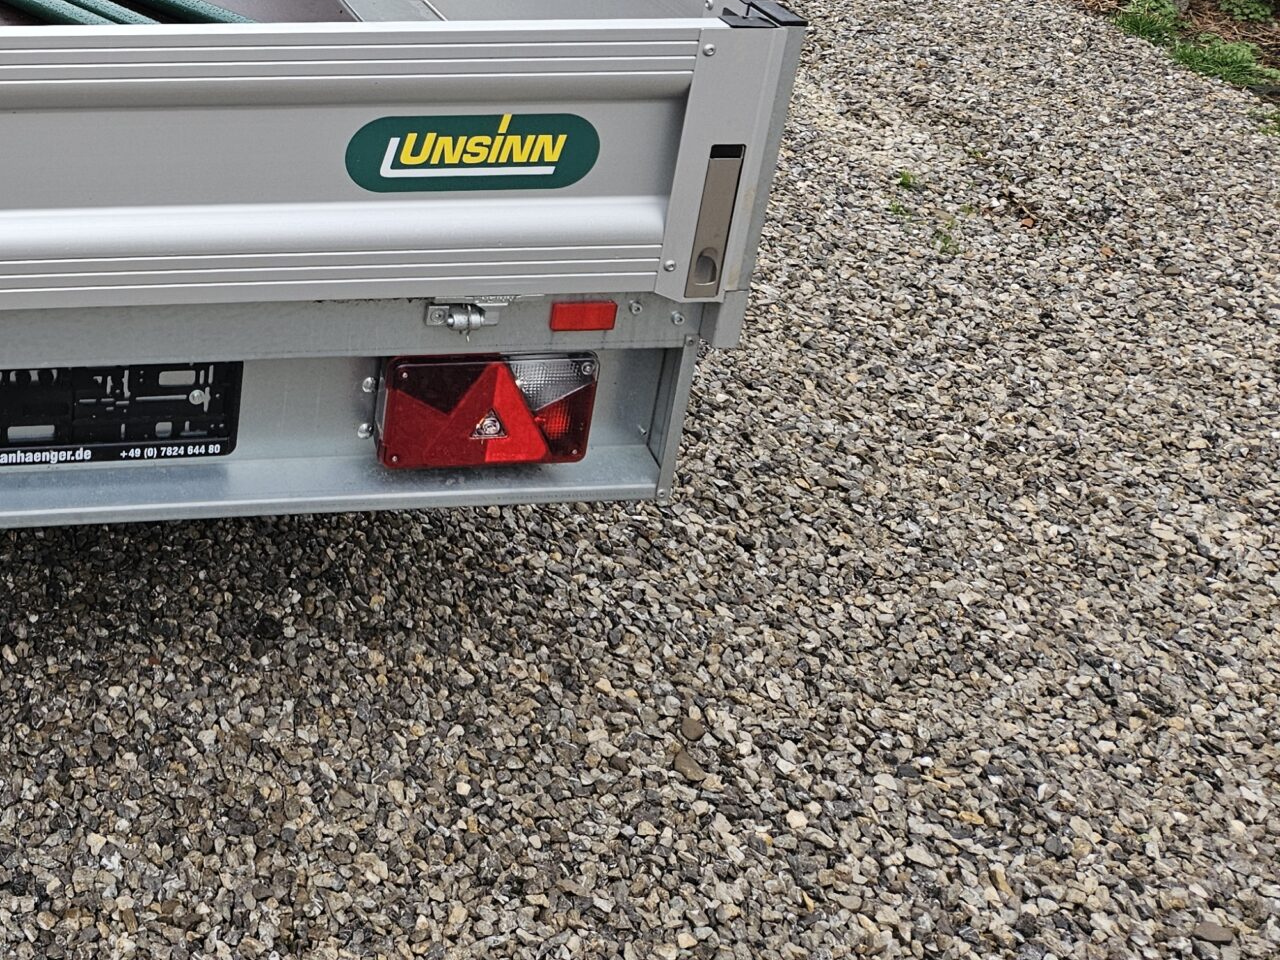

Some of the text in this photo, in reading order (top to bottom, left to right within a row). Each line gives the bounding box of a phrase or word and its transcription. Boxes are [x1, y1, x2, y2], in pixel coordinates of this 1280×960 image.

[399, 113, 568, 166] UNSINN
[120, 443, 221, 459] +49 (0) 7824 644 80
